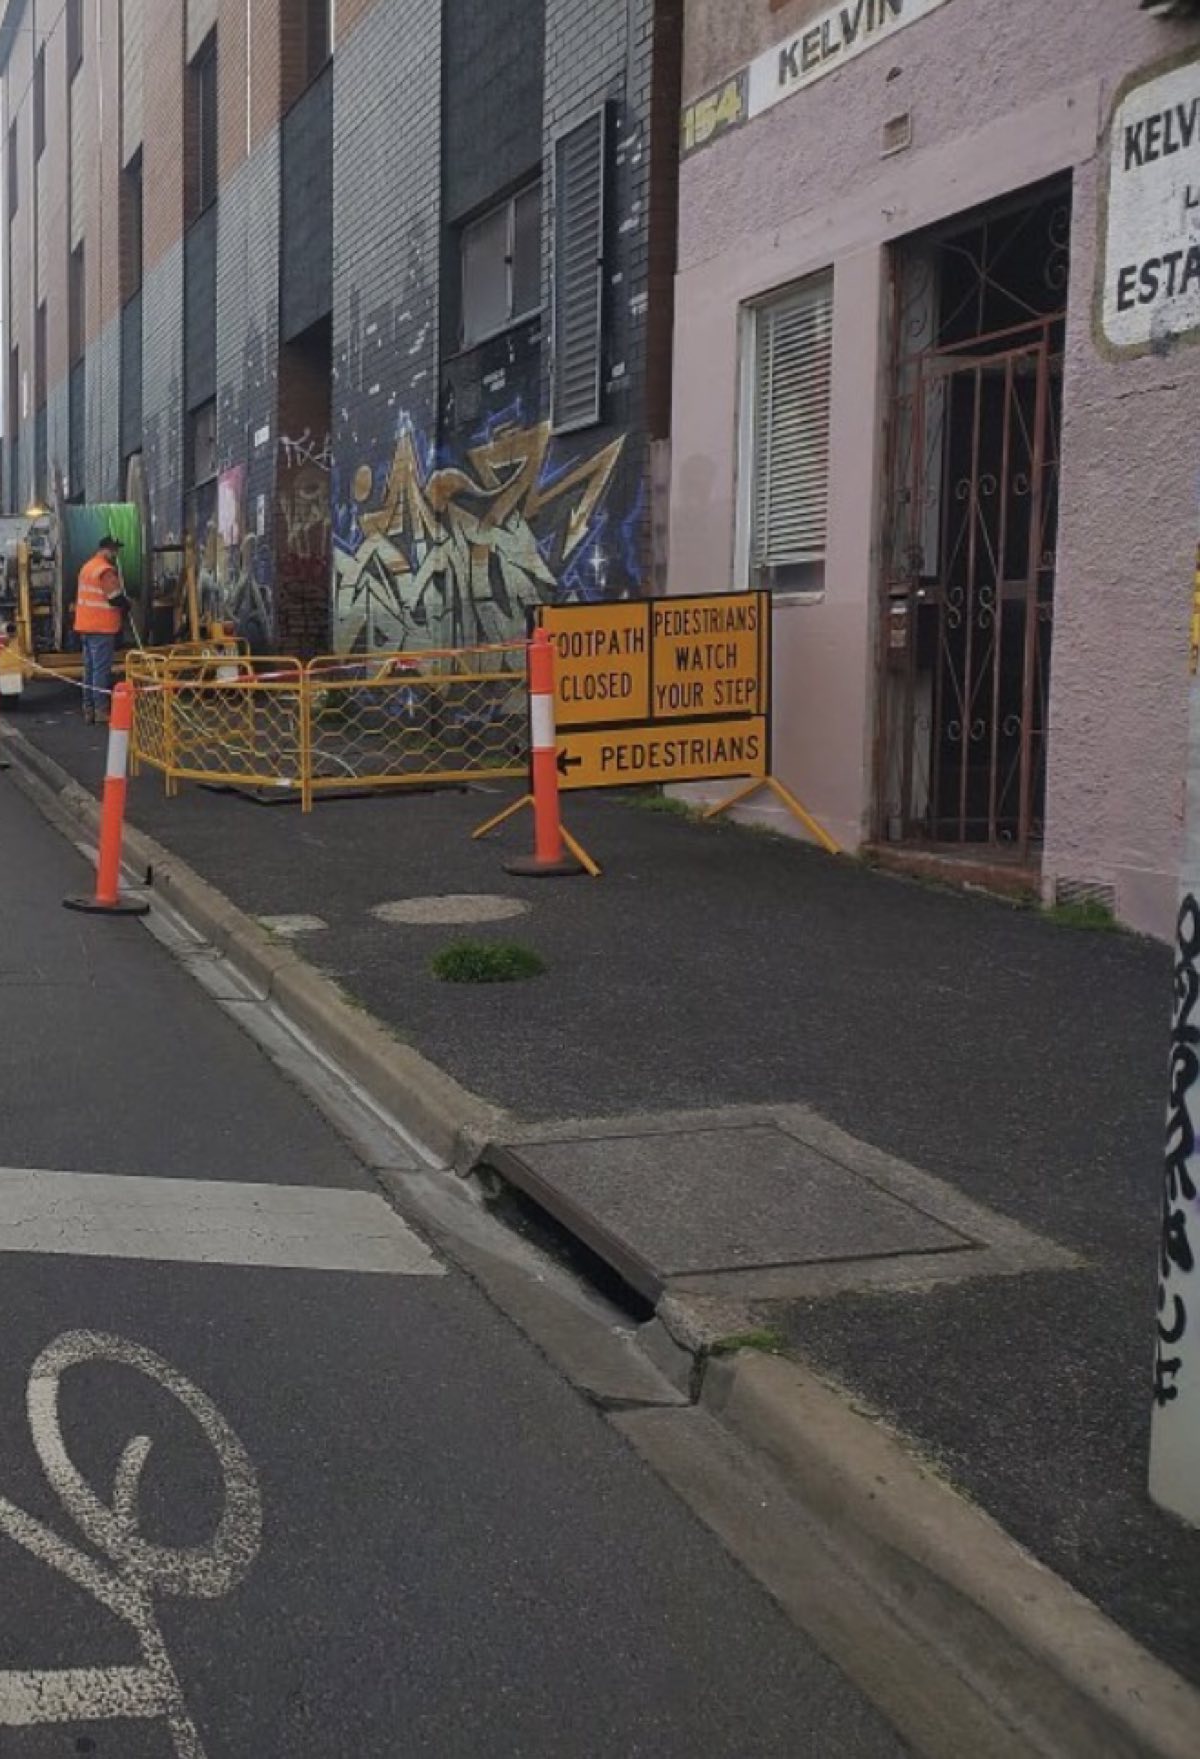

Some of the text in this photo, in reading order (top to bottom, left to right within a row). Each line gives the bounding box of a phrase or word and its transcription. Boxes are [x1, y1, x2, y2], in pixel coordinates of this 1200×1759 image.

[654, 606, 757, 638] PEDESTRIANS
[675, 643, 737, 672] WATCH
[560, 671, 633, 703] CLOSED
[656, 678, 757, 710] YOUR STEP
[601, 735, 760, 772] PEDESTRIANS
